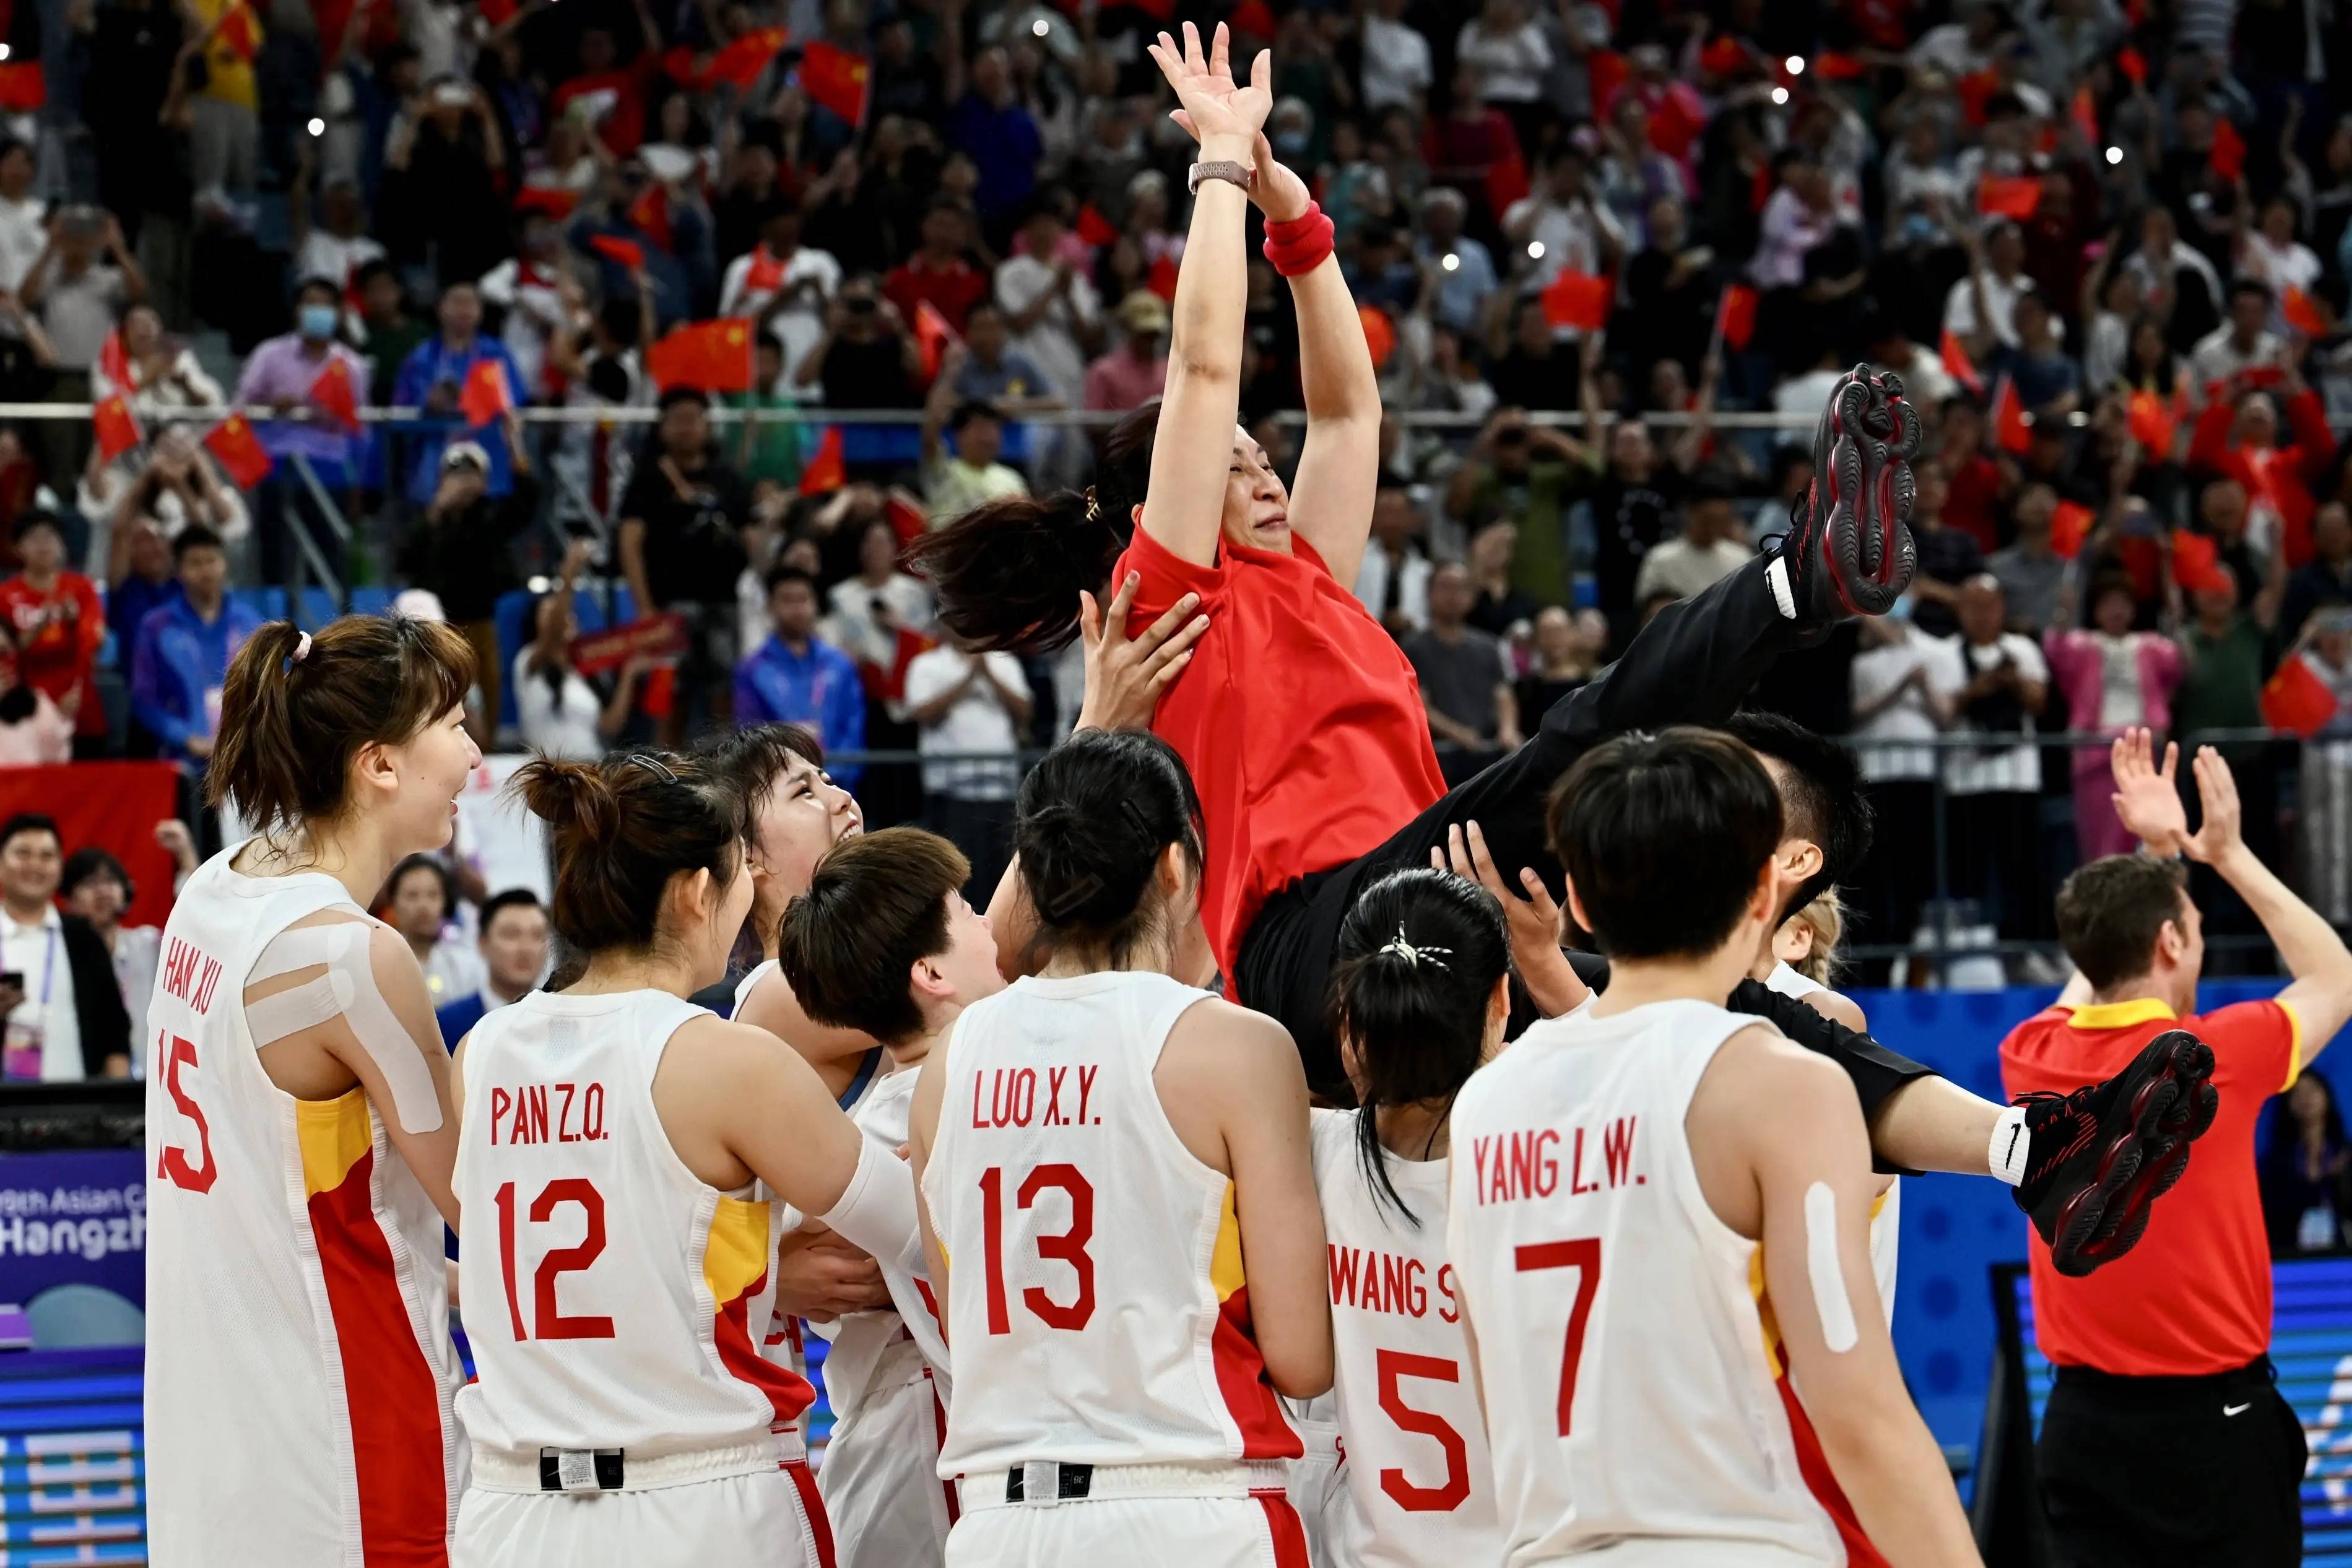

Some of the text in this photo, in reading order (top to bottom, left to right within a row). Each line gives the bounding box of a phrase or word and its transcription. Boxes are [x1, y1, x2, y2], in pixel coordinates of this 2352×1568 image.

[163, 936, 222, 1015] HAN XU
[491, 1082, 609, 1146] PAN Z.Q.
[973, 1065, 1101, 1128] LUO X.Y.
[50, 1185, 124, 1215] Asian
[1473, 1116, 1647, 1206] YANG L.W.
[494, 1178, 616, 1342] 12
[979, 1163, 1096, 1336] 13
[1328, 1244, 1427, 1319] WANG
[1515, 1237, 1602, 1438] 7
[1376, 1348, 1471, 1512] 5
